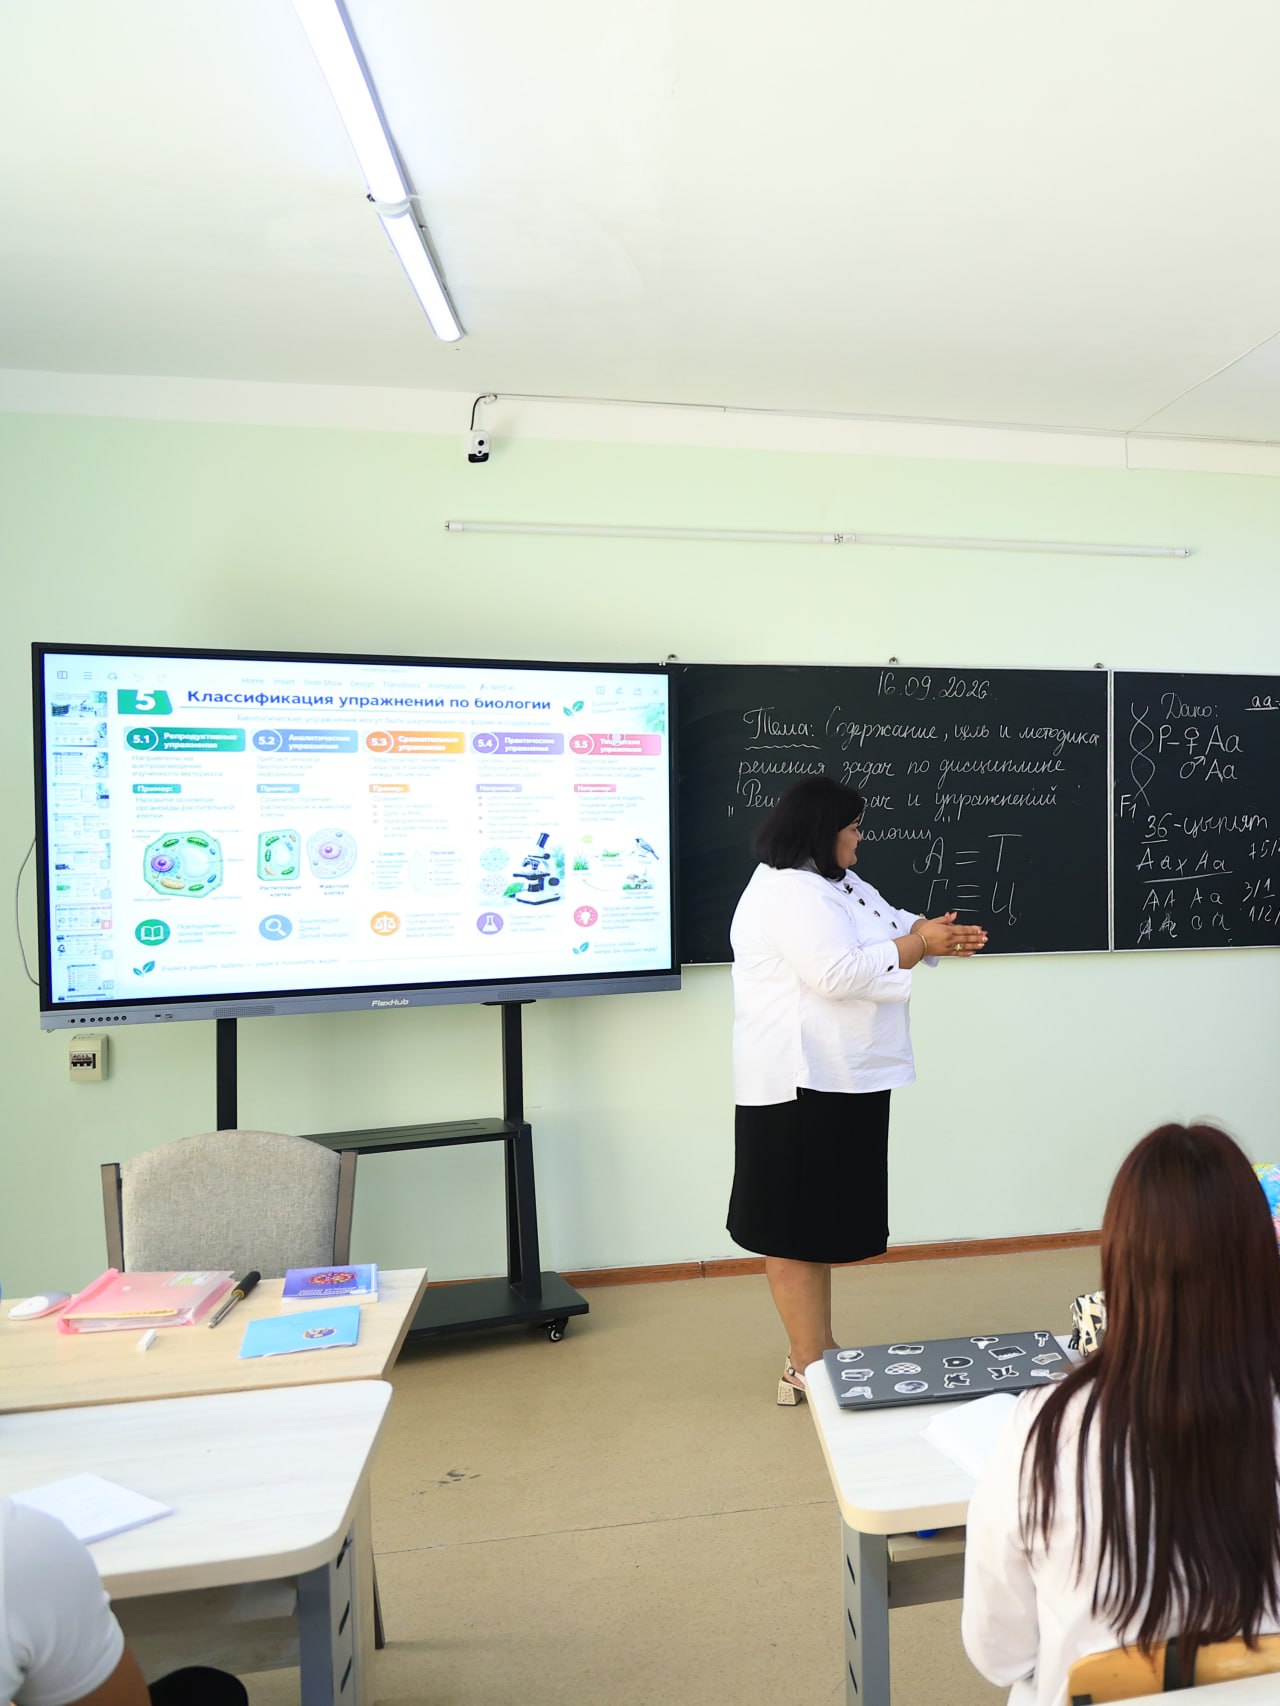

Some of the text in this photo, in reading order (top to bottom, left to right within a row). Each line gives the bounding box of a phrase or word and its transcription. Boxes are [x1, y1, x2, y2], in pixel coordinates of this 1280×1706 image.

[134, 689, 156, 711] 5
[186, 690, 552, 710] Классификация упражнений по биологии
[1160, 692, 1219, 720] Дано:
[742, 706, 815, 740] Тема:
[1018, 726, 1100, 756] методика
[132, 734, 150, 744] 5.1
[258, 736, 276, 746] 5.2
[371, 737, 388, 747] 5.3
[477, 738, 493, 748] 5.4
[573, 740, 589, 749] 5.5
[736, 760, 826, 794] решения
[839, 760, 895, 789] задач
[906, 759, 930, 774] по
[371, 998, 409, 1007] FlexHub
